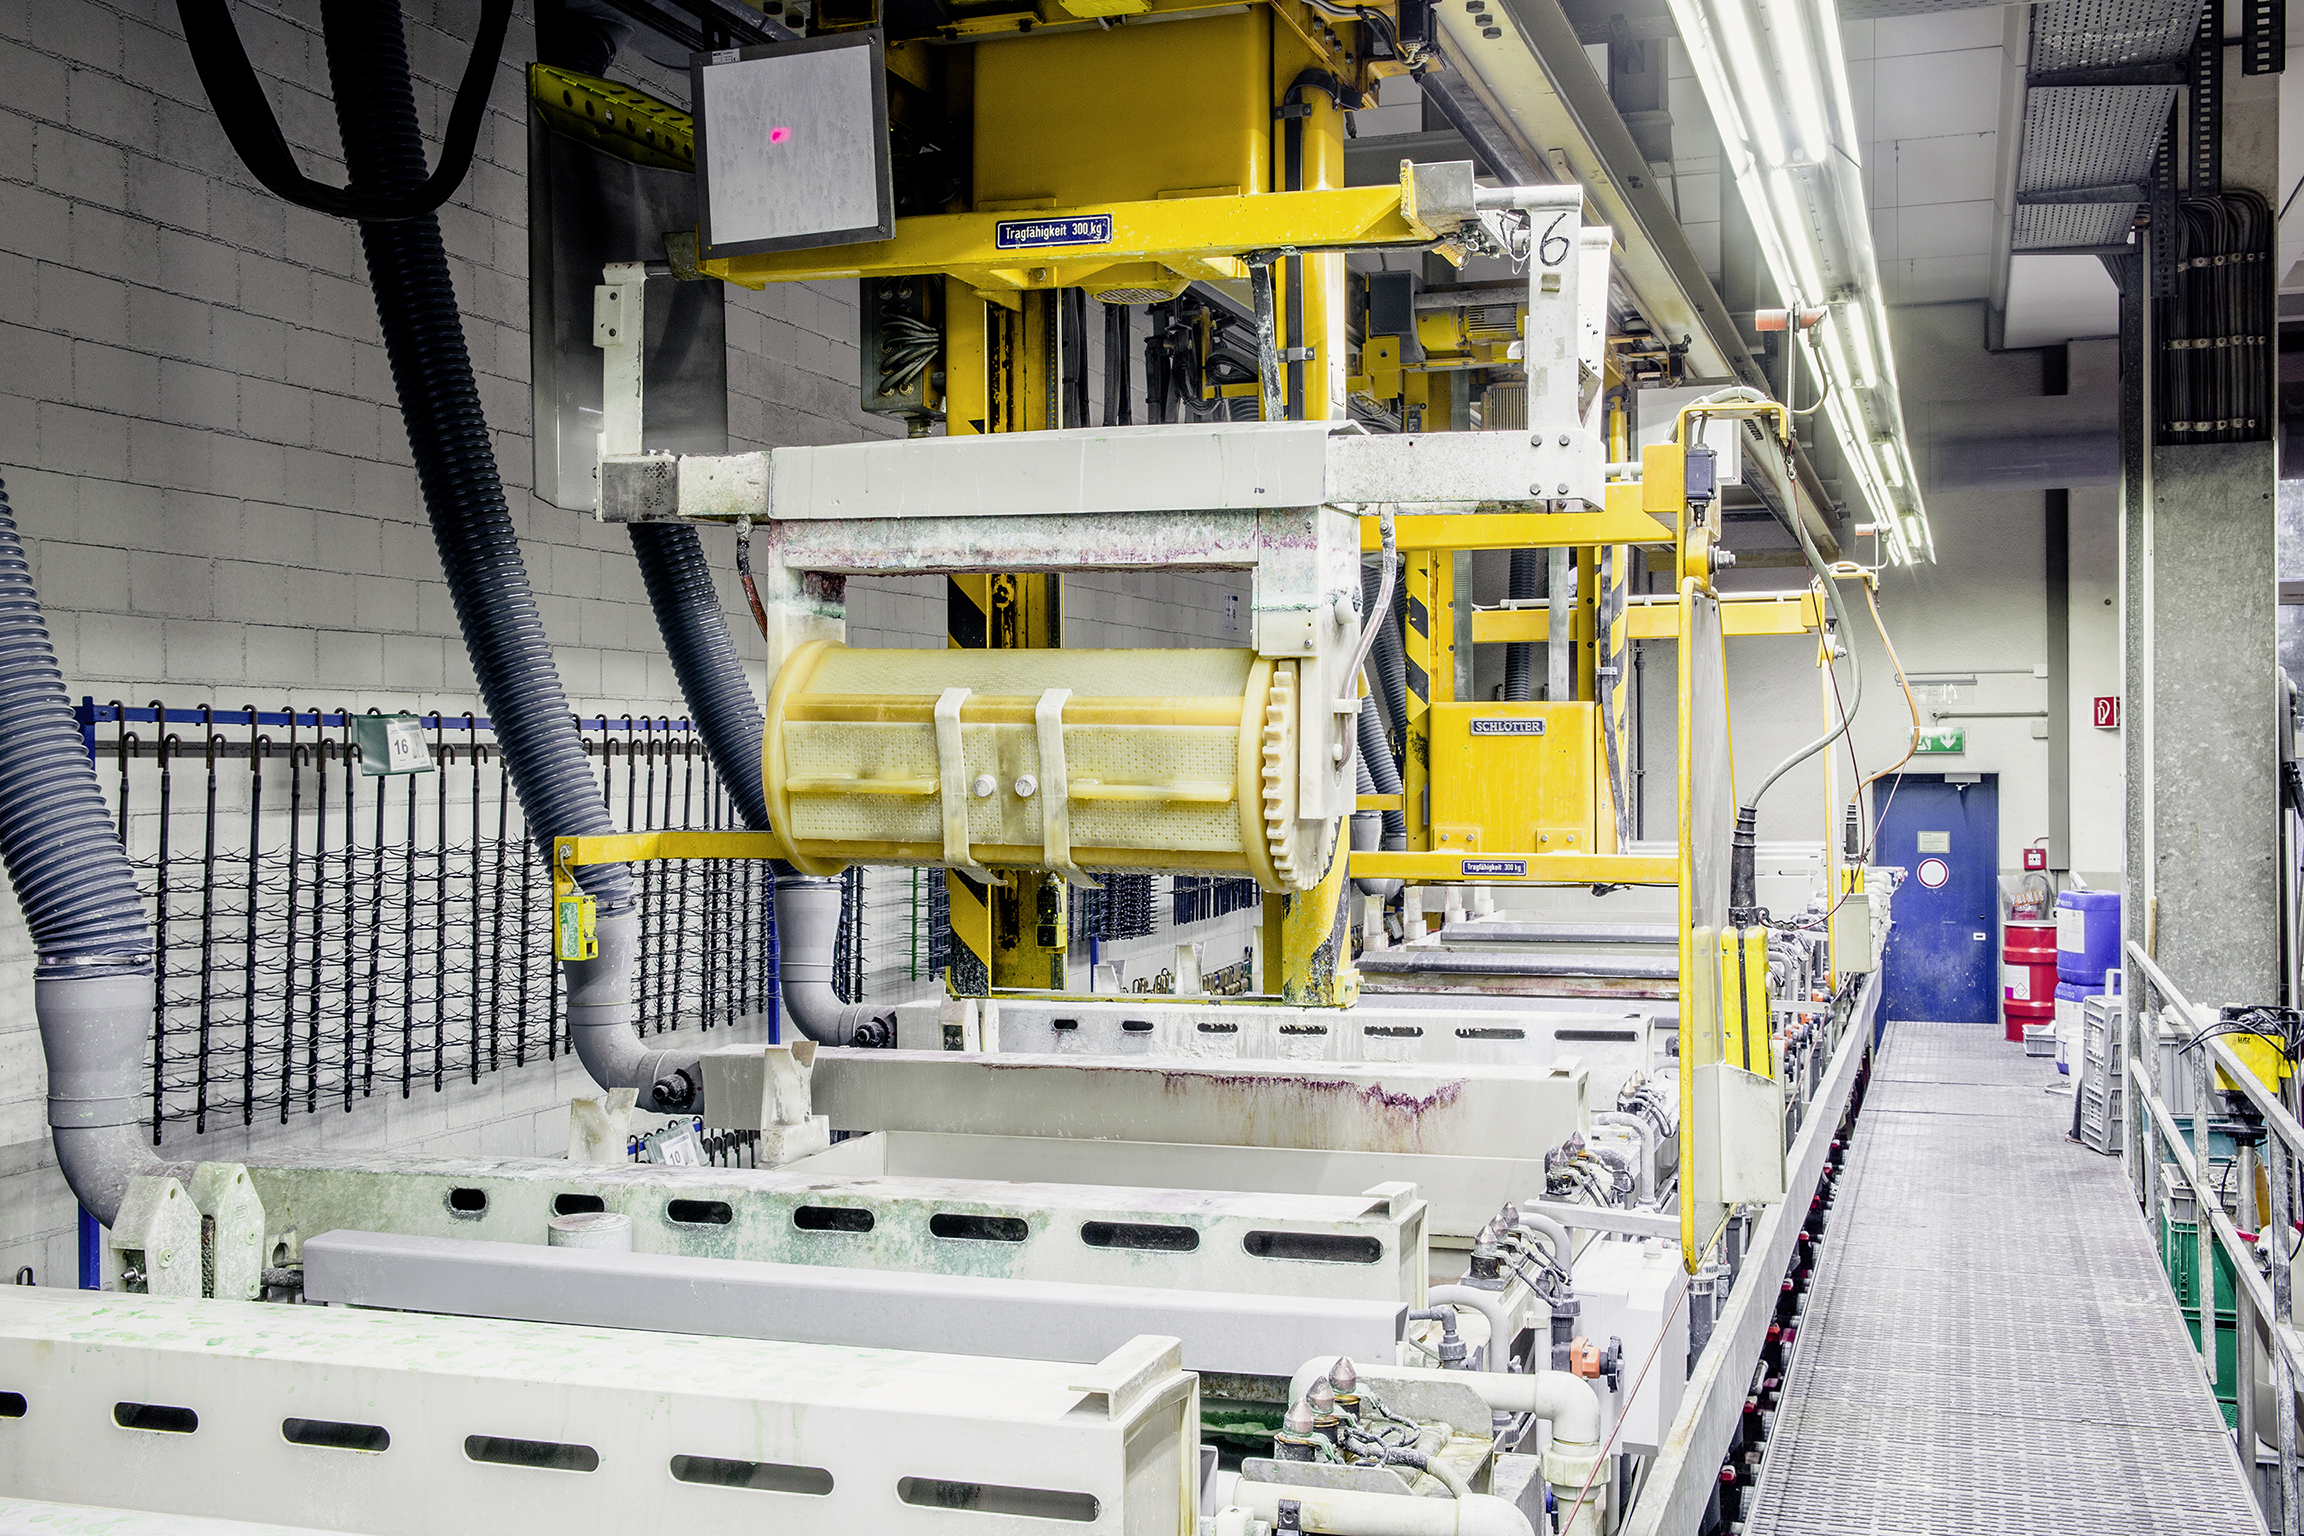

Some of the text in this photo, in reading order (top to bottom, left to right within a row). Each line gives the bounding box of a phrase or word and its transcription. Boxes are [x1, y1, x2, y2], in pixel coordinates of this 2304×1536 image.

[1005, 222, 1102, 242] Tragfähigkeit 300 kg
[1540, 212, 1570, 267] 6
[1475, 720, 1541, 732] SCHLÖTTER
[394, 738, 410, 755] 16
[2011, 890, 2045, 905] PRIMUS
[669, 1150, 681, 1166] 10
